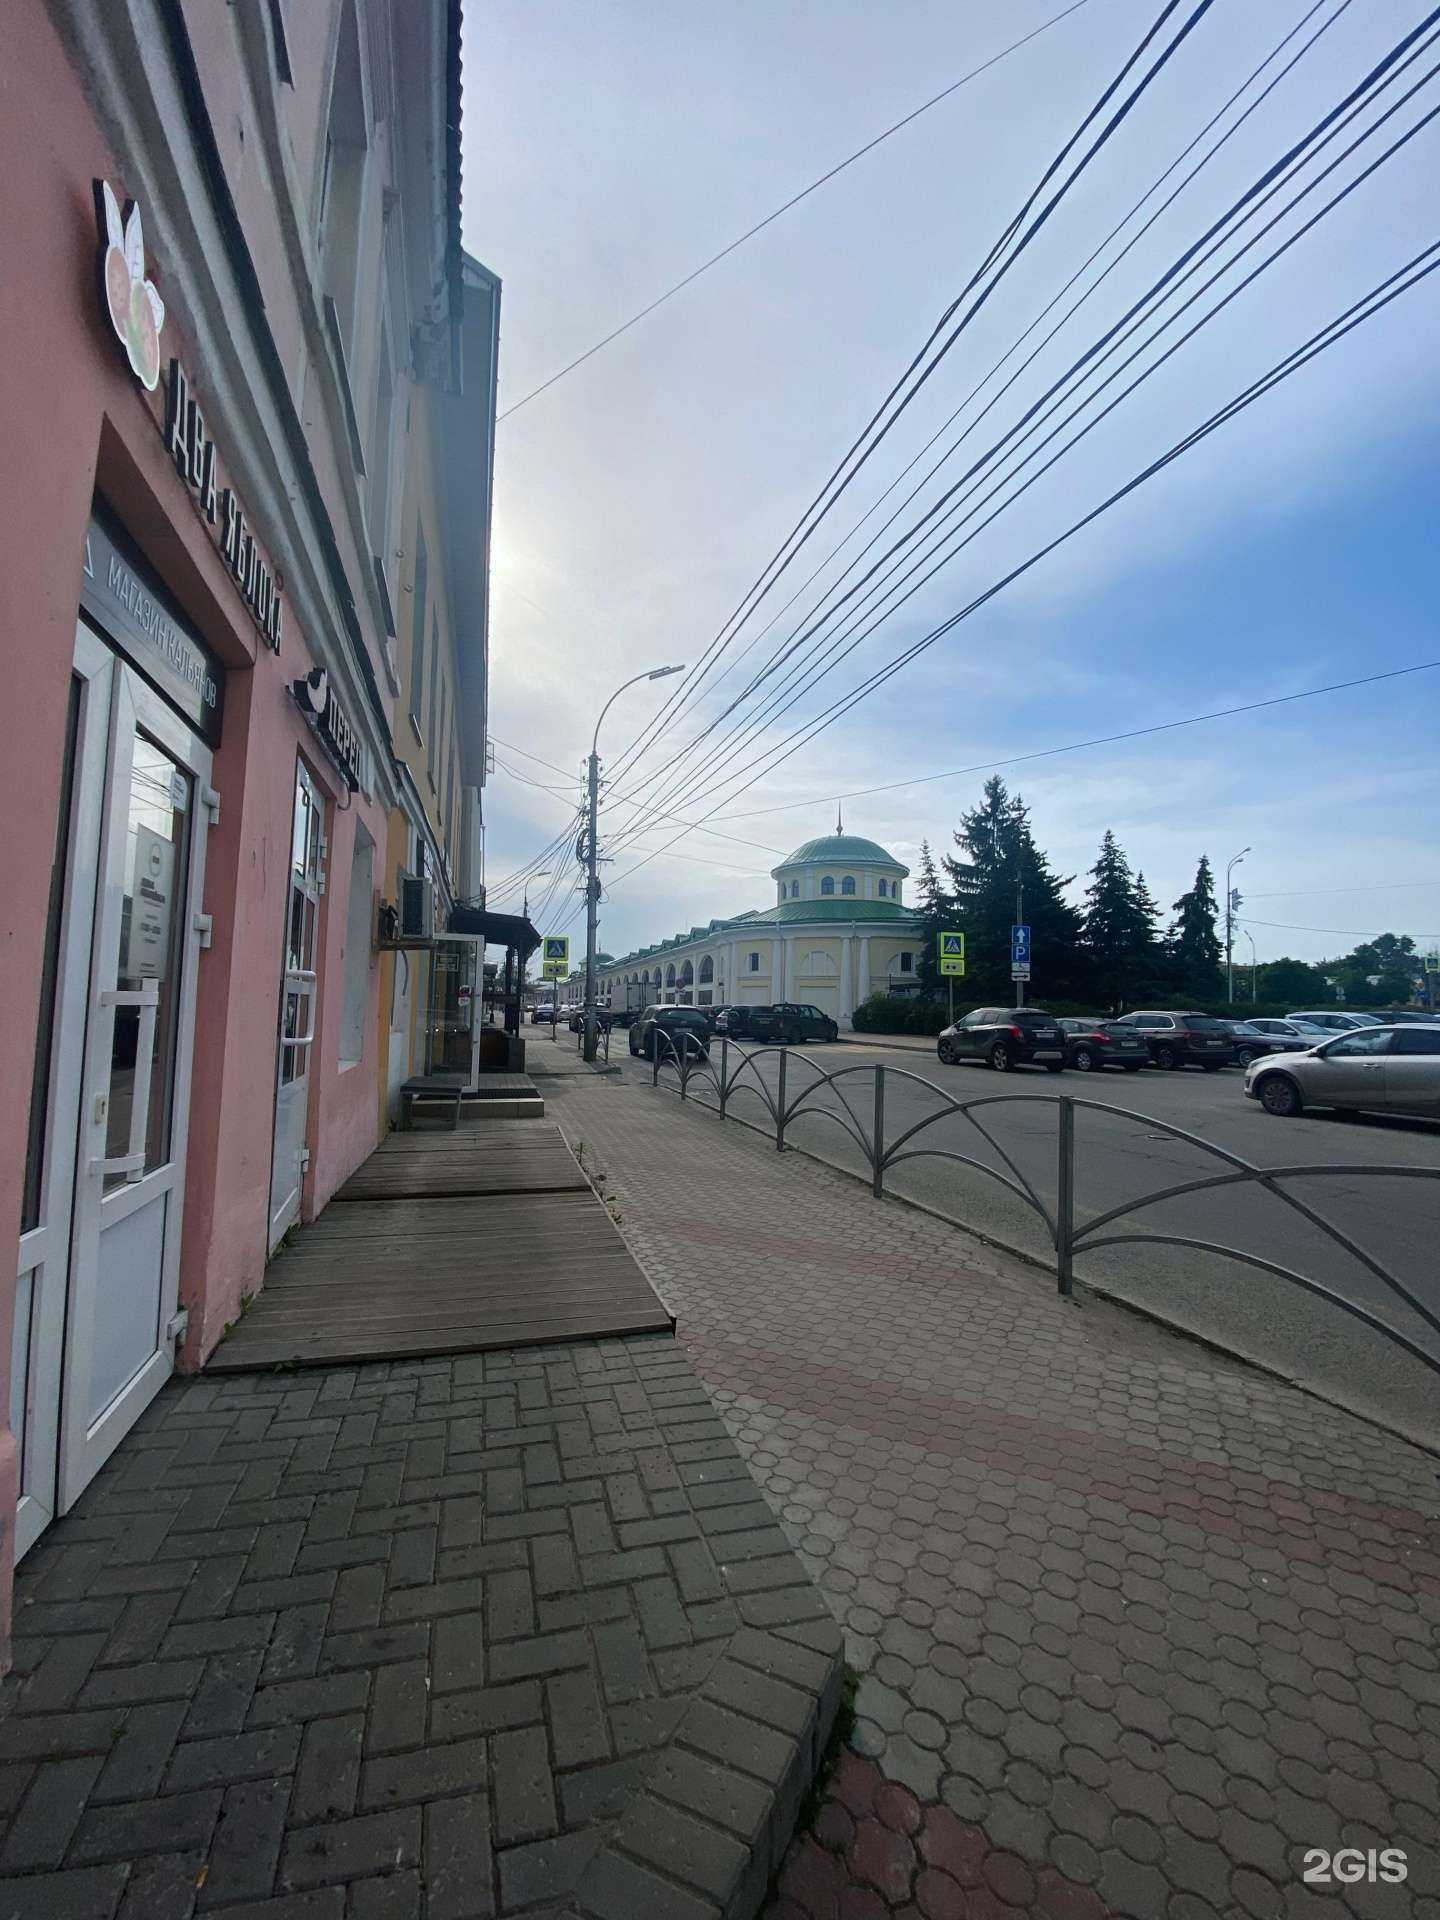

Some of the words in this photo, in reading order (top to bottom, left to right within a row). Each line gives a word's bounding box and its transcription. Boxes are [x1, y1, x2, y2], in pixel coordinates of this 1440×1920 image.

[166, 358, 217, 525] ДВА
[222, 487, 282, 657] ЯБЛОКА
[107, 555, 166, 650] МАГАЗИН
[166, 622, 217, 708] КАЛЬЯНОВ
